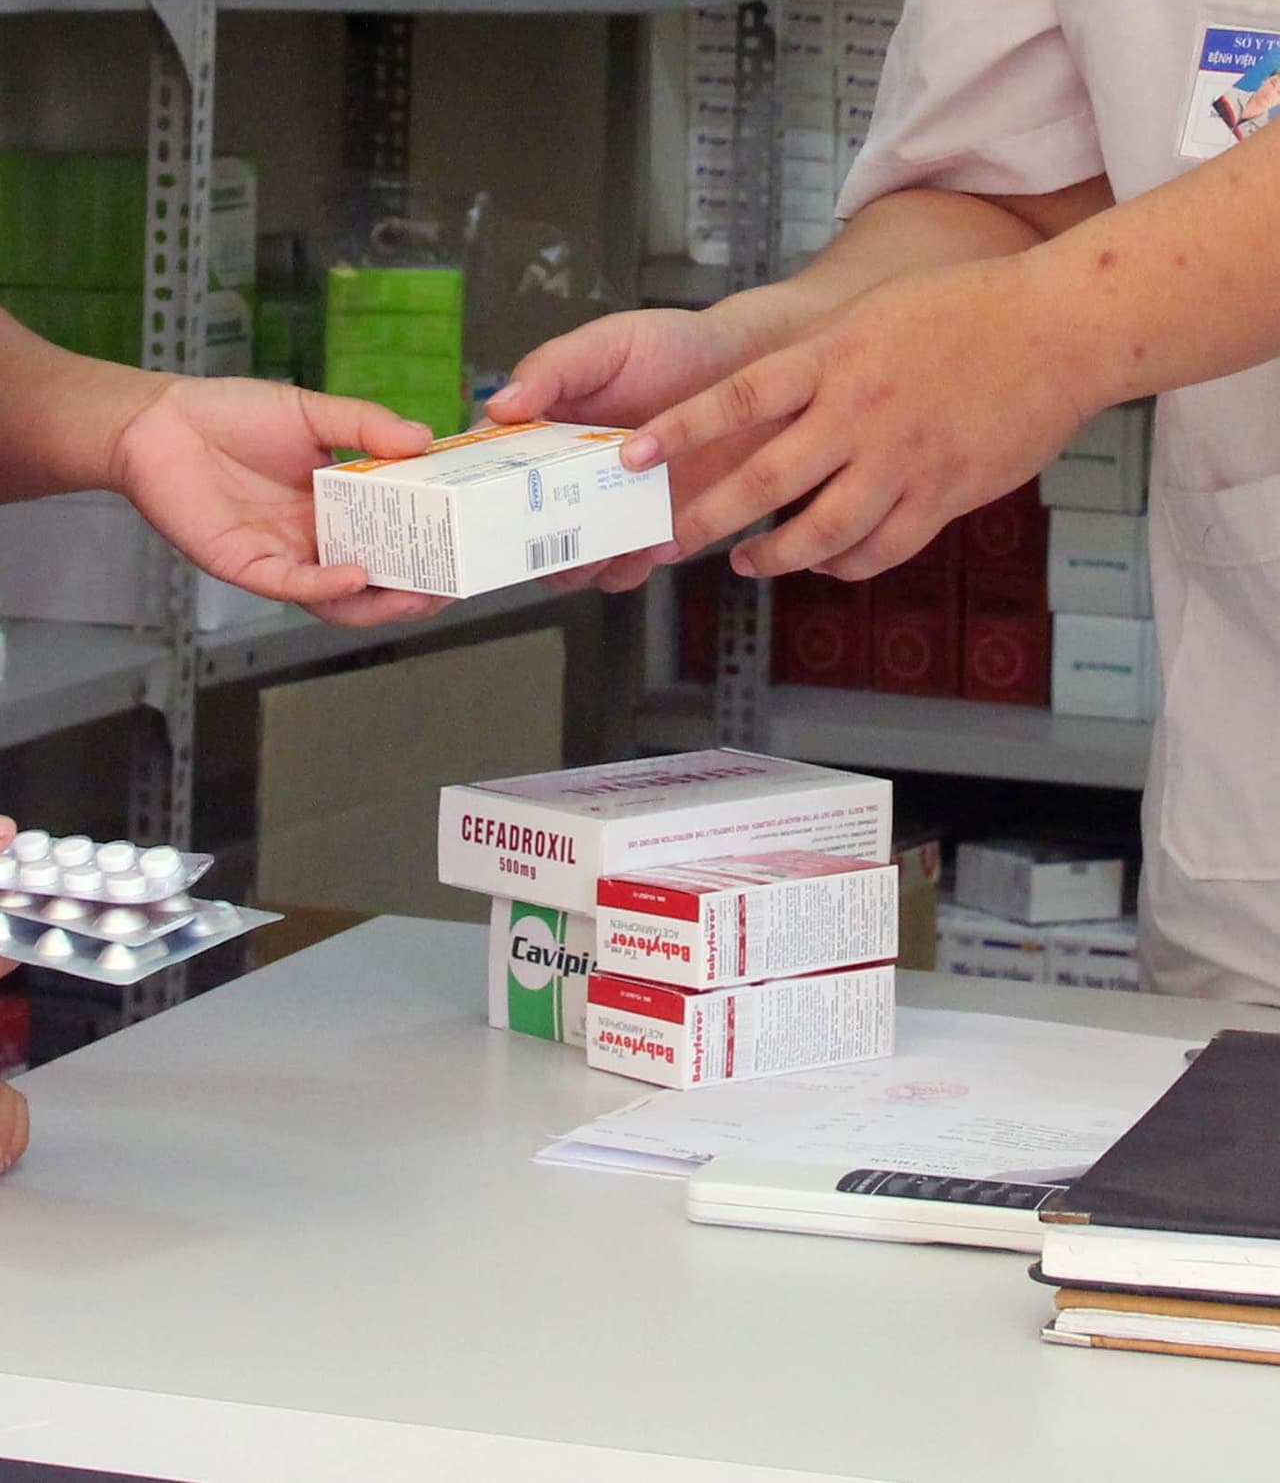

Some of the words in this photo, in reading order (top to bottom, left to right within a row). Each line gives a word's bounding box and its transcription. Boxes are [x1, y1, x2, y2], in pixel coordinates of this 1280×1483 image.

[460, 814, 577, 865] CEFADROXIL
[499, 857, 537, 880] 500mg
[610, 933, 691, 964] Babyfever
[707, 907, 717, 981] Babyfever
[598, 1030, 675, 1064] Babyfever
[692, 1009, 703, 1083] Babyfever
